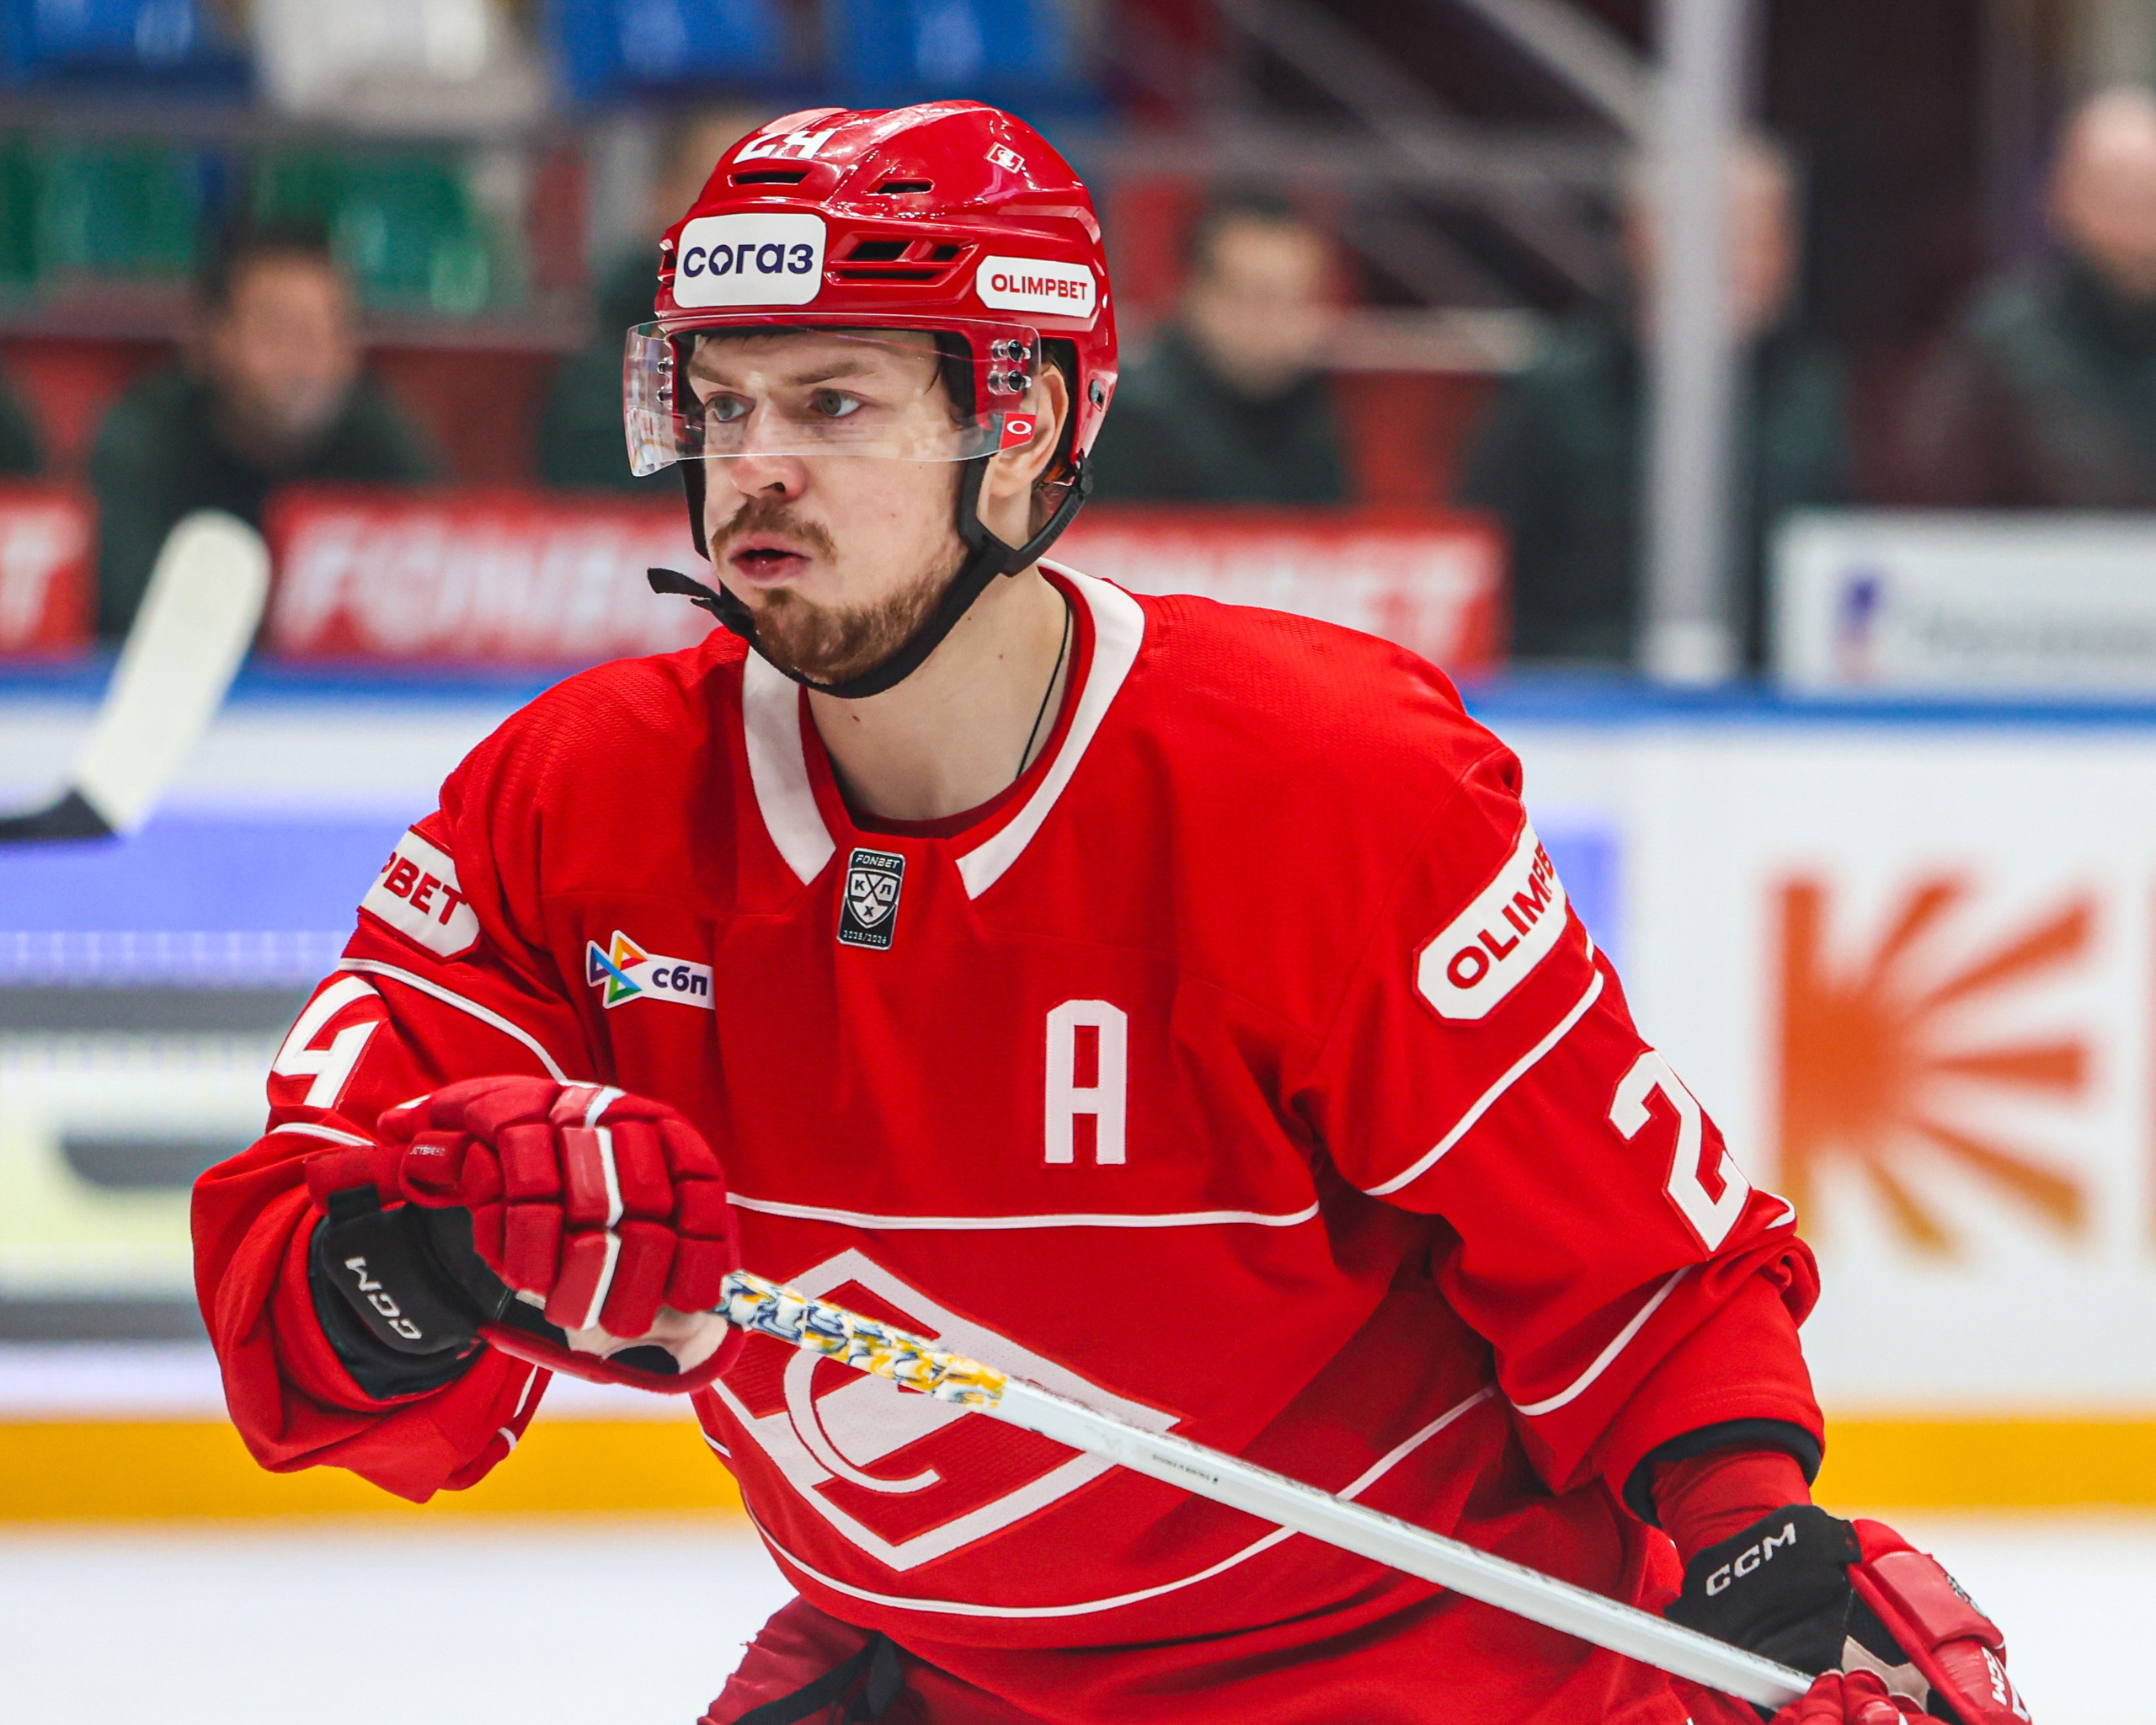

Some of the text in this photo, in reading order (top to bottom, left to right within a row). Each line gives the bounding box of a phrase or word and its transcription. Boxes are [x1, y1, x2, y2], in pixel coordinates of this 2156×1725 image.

[731, 128, 838, 164] 24
[990, 273, 1088, 301] OLIMPBET
[855, 854, 900, 869] FONBET
[842, 929, 888, 945] 2025/2026
[272, 976, 382, 1109] 4
[1044, 999, 1128, 1165] A
[1608, 1049, 1751, 1252] 2
[344, 1256, 423, 1339] CCM
[1706, 1522, 1796, 1596] CCM
